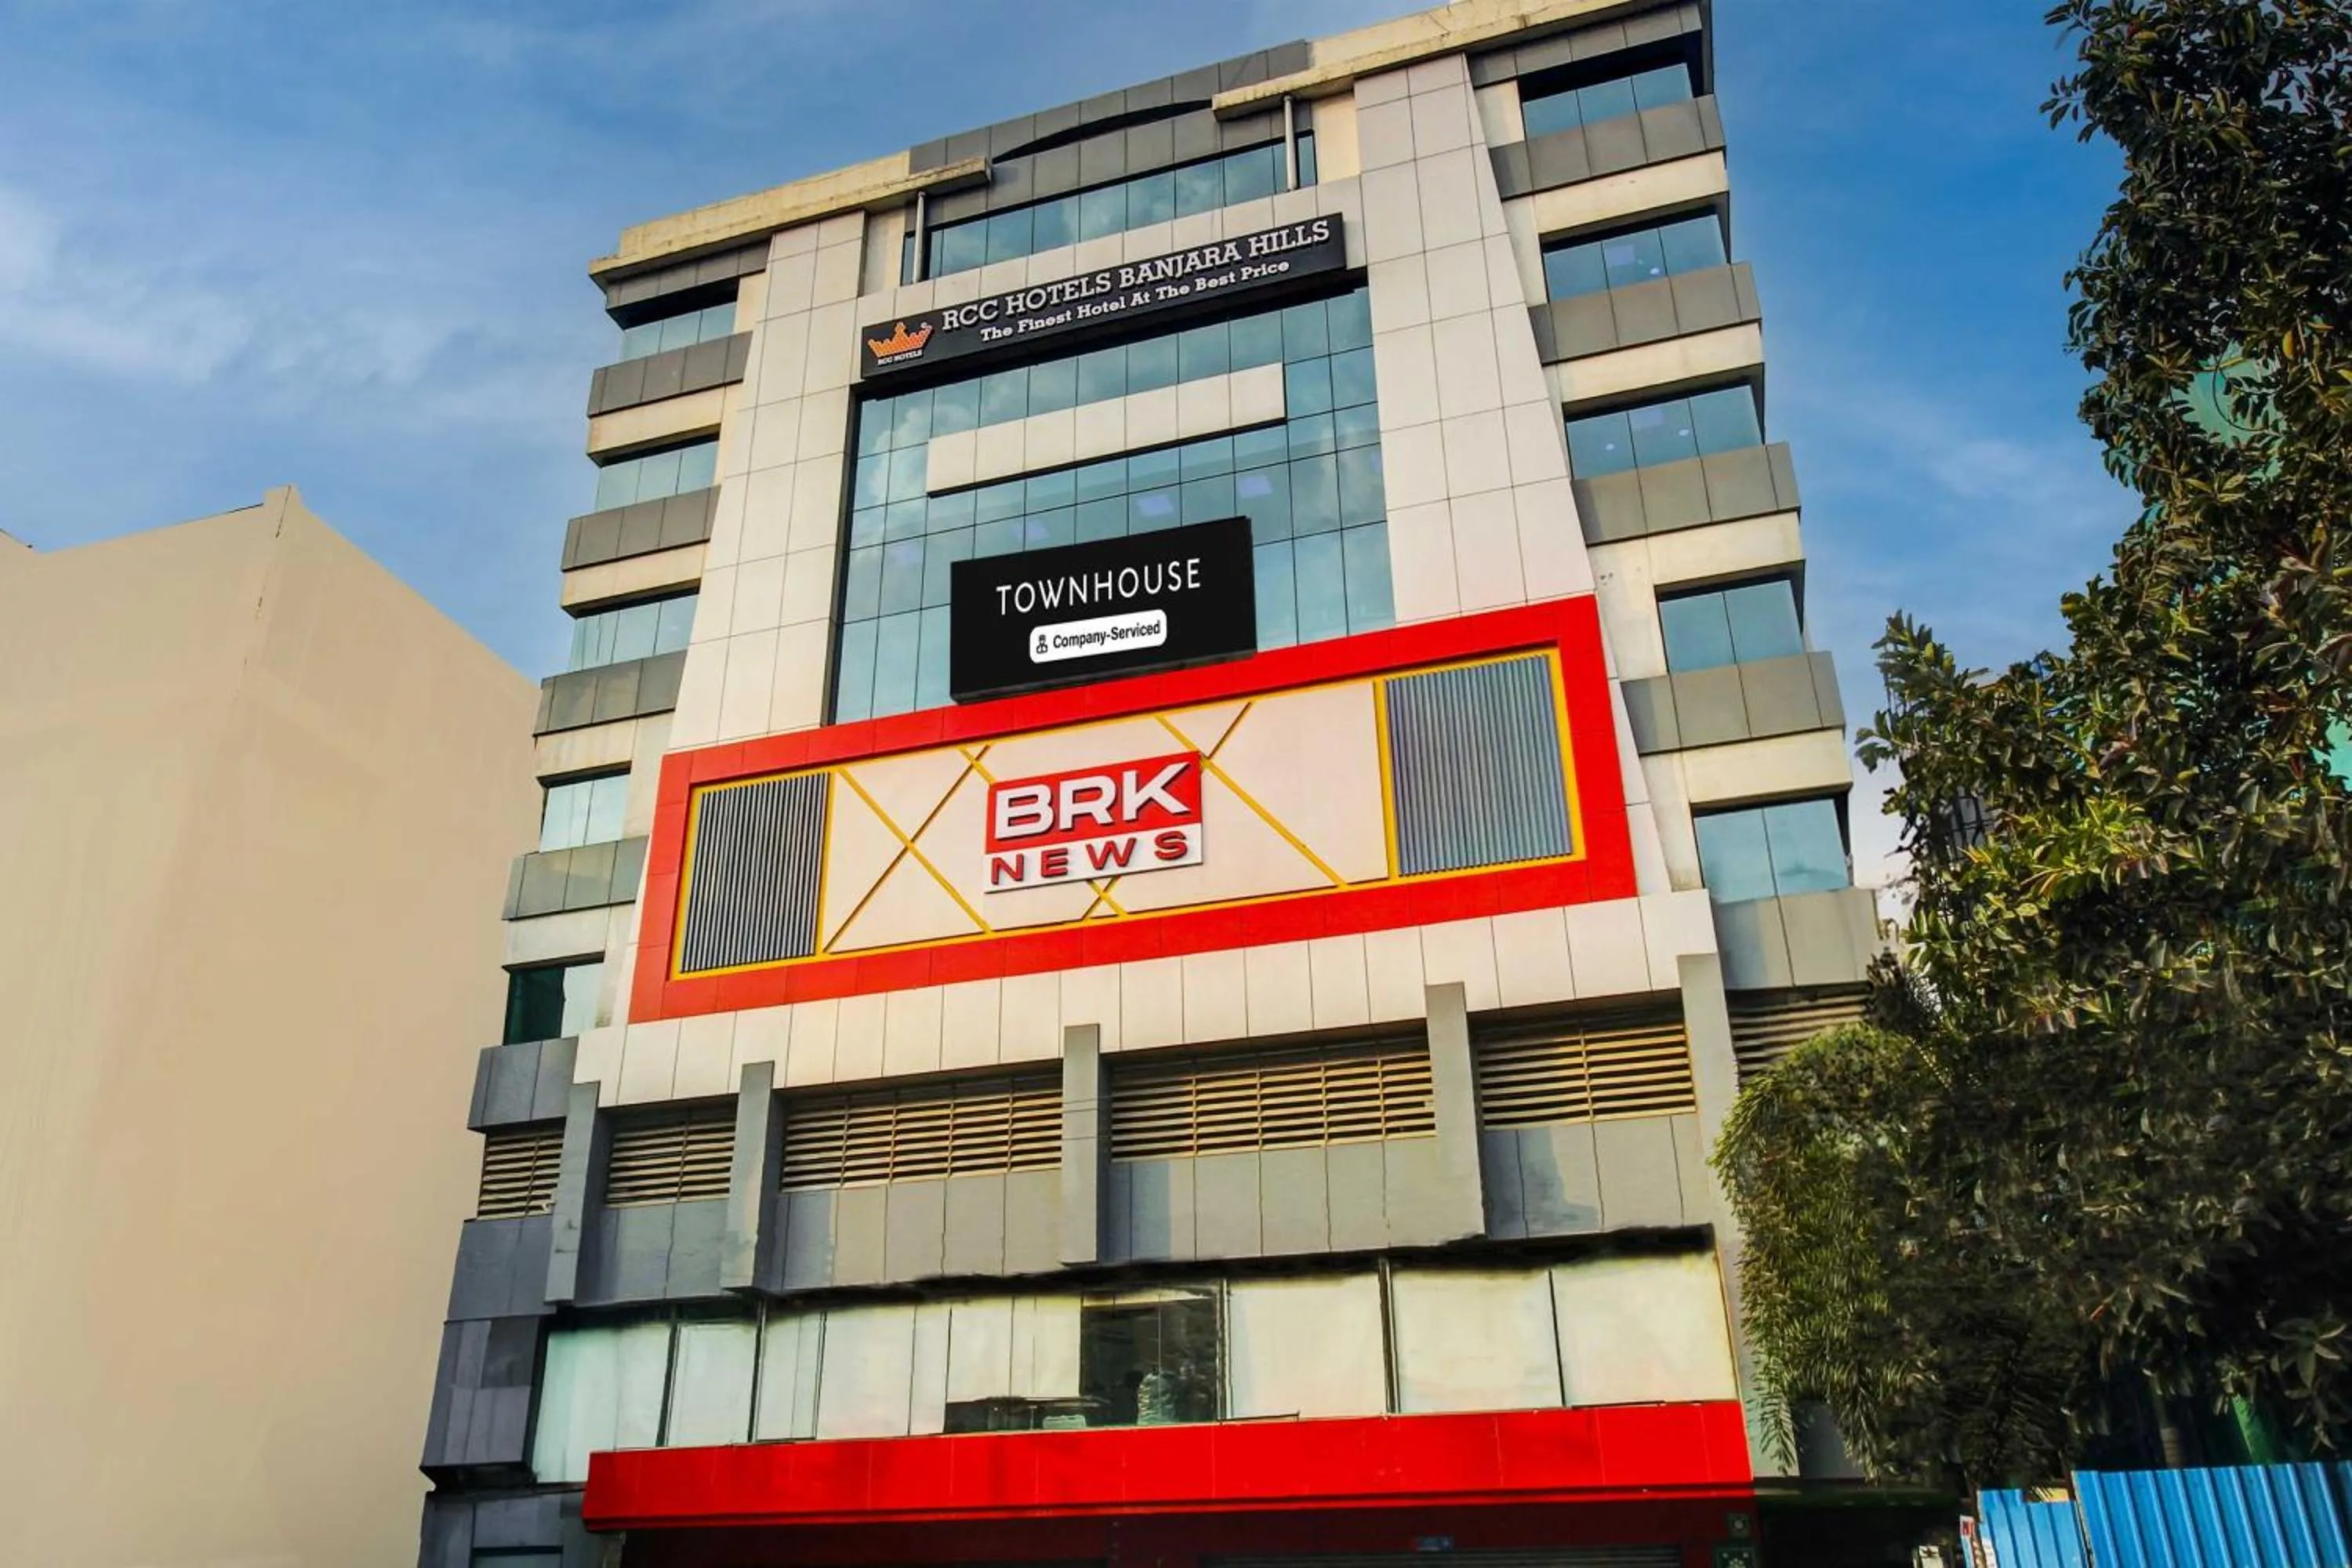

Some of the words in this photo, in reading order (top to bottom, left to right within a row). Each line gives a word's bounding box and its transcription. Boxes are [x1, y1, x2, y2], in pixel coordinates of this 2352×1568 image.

[942, 299, 999, 330] RCC
[1005, 272, 1112, 316] HOTELS
[1119, 241, 1243, 289] BANJARA
[1248, 220, 1330, 258] HILLS
[981, 325, 1014, 342] The
[1018, 310, 1073, 334] Finest
[1076, 296, 1126, 319] Hotel
[1130, 291, 1151, 307] At
[1156, 284, 1190, 301] The
[1195, 270, 1236, 292] Best
[1241, 260, 1290, 281] Price
[996, 557, 1201, 616] TOWNHOUSE
[1052, 619, 1161, 649] Company-Serviced
[994, 761, 1191, 841] BRK
[991, 830, 1189, 884] NEWS
